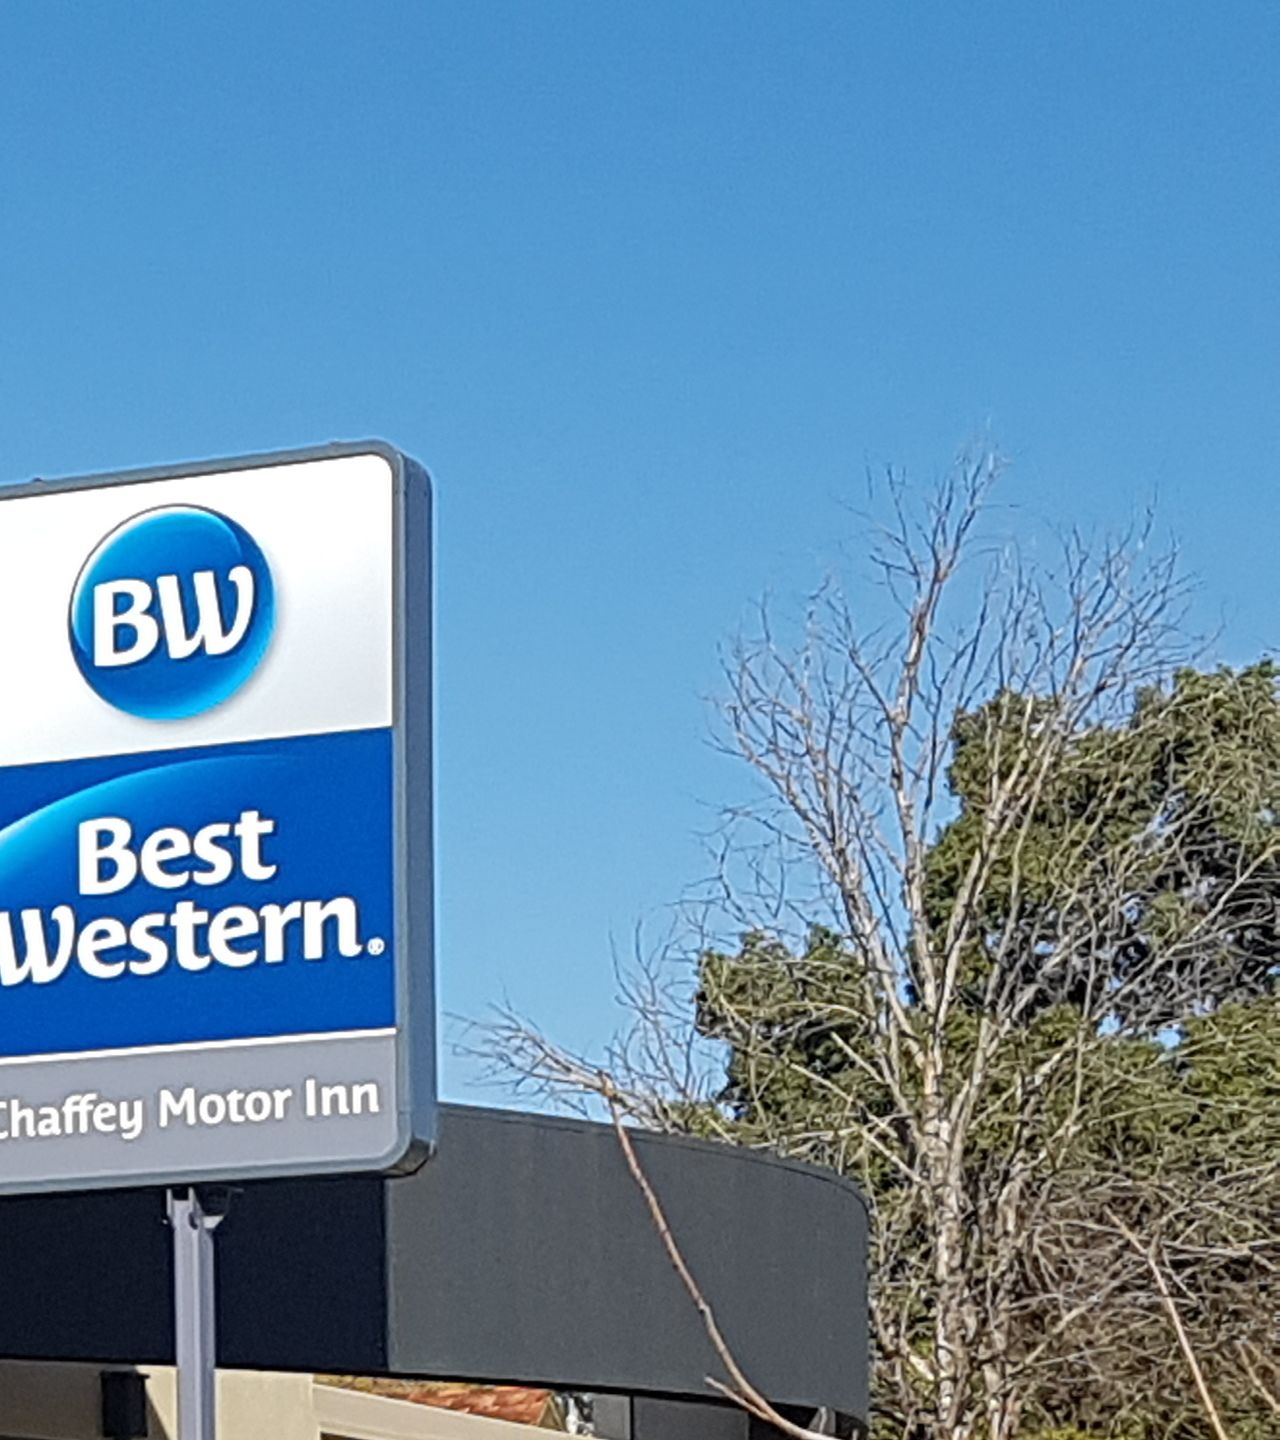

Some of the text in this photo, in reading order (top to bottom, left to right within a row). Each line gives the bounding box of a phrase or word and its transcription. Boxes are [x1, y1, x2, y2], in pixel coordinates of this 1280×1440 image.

[92, 565, 255, 668] BW
[77, 810, 278, 896] Best
[158, 1086, 293, 1128] Motor
[304, 1078, 381, 1117] Inn
